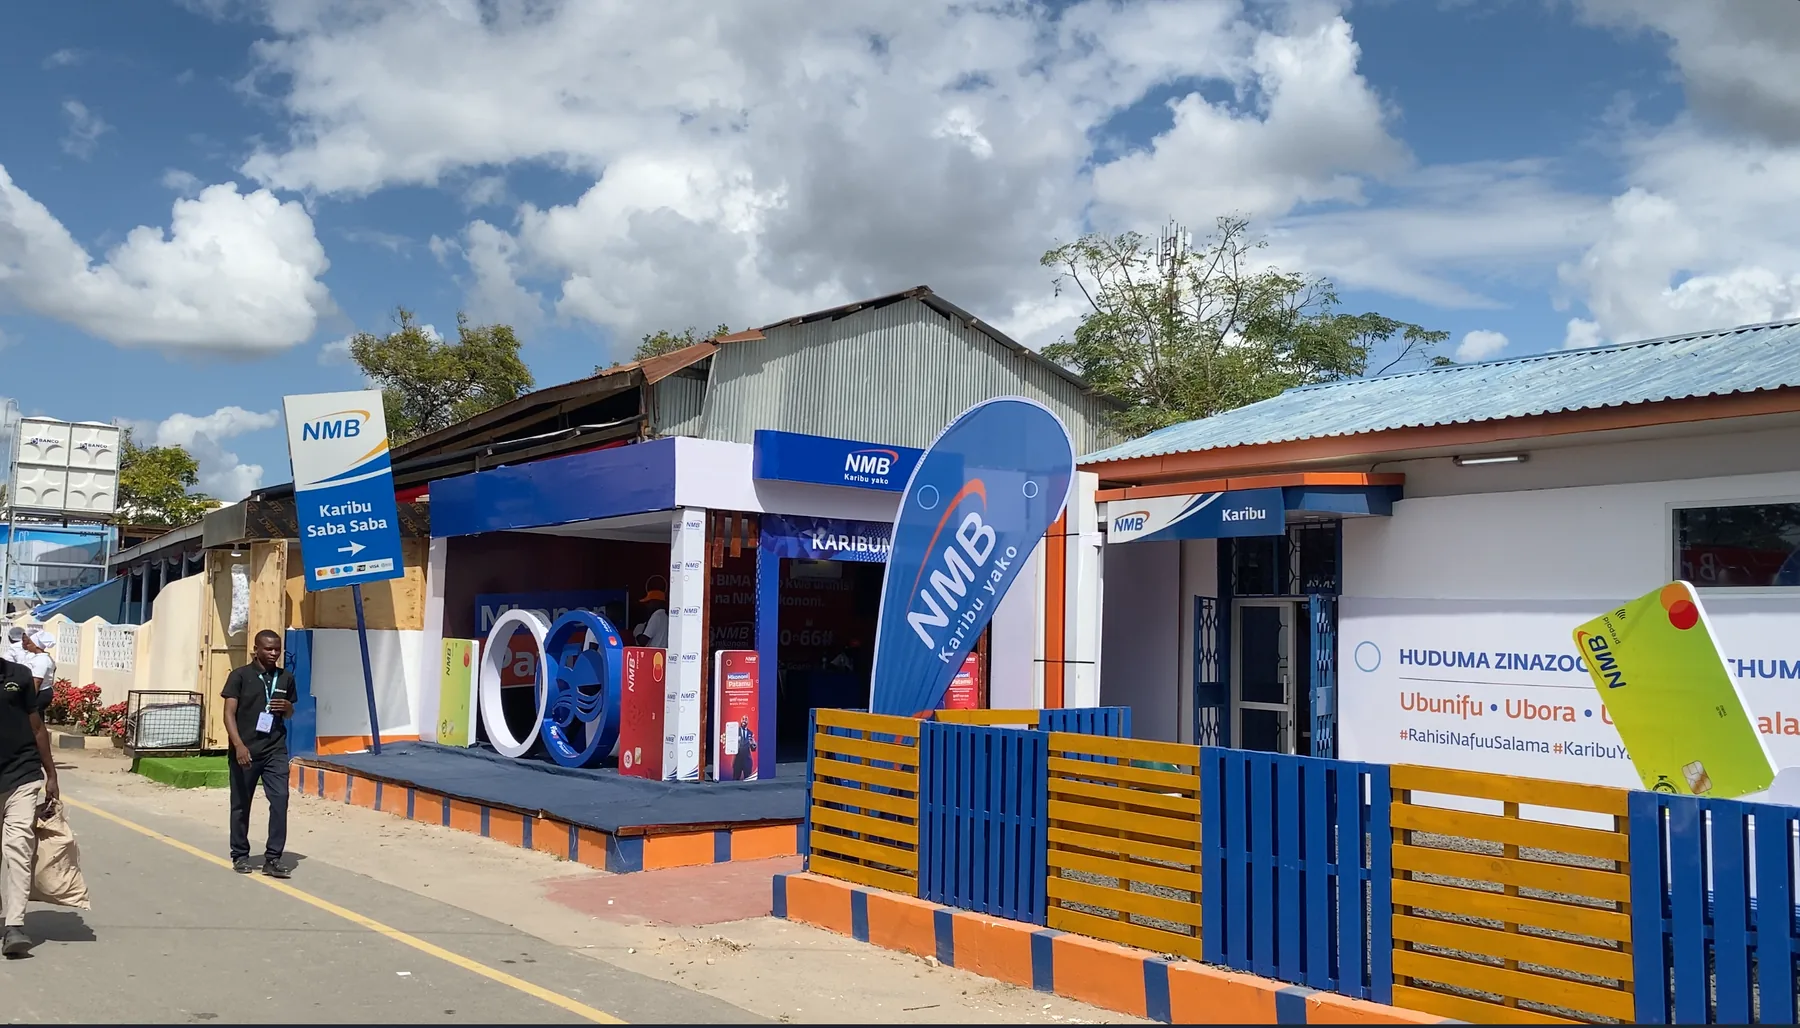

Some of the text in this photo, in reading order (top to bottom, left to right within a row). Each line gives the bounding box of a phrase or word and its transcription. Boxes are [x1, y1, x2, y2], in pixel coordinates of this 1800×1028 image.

[302, 419, 360, 441] NMB
[844, 453, 891, 475] NMB
[844, 473, 869, 482] Karibu
[319, 501, 372, 518] Karibu
[1222, 507, 1266, 522] Karibu
[307, 520, 347, 538] Saba
[350, 517, 388, 533] Saba
[1113, 517, 1144, 532] NMB
[717, 574, 751, 587] BIMA
[907, 512, 996, 650] NMB
[715, 594, 730, 604] na
[938, 598, 985, 664] Karibu
[982, 546, 1017, 595] yako
[716, 626, 749, 639] NMB
[1602, 616, 1622, 645] prepaid
[1399, 649, 1490, 669] HUDUMA
[1588, 635, 1627, 689] NMB
[1400, 692, 1483, 720] Ubunifu
[1506, 698, 1576, 722] Ubora
[1400, 728, 1550, 754] #RahisiNafuuSalama
